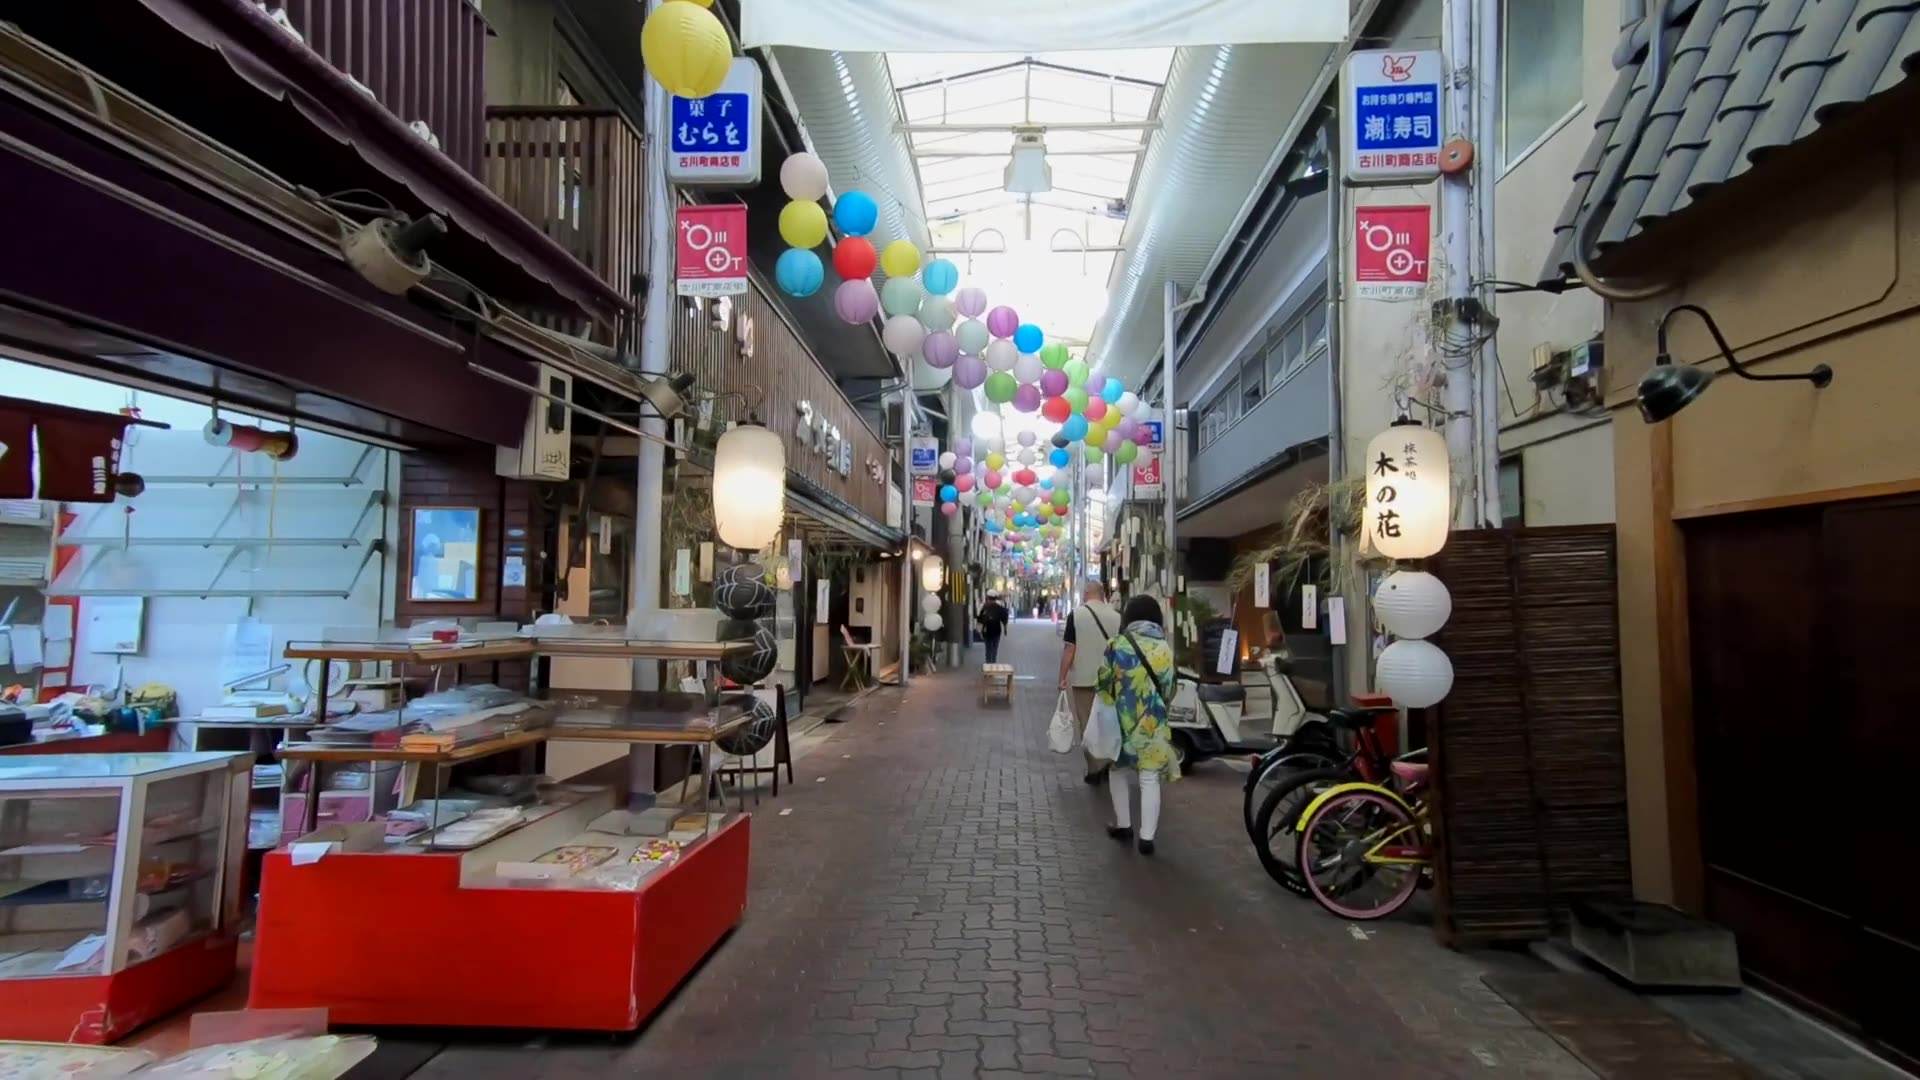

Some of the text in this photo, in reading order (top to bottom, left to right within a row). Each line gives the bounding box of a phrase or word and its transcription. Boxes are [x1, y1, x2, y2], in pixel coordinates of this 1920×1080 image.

[678, 121, 740, 145] むらを
[679, 155, 740, 168] 古川町商店街
[1359, 152, 1437, 168] 古川町商店街
[1374, 451, 1401, 539] 木の花
